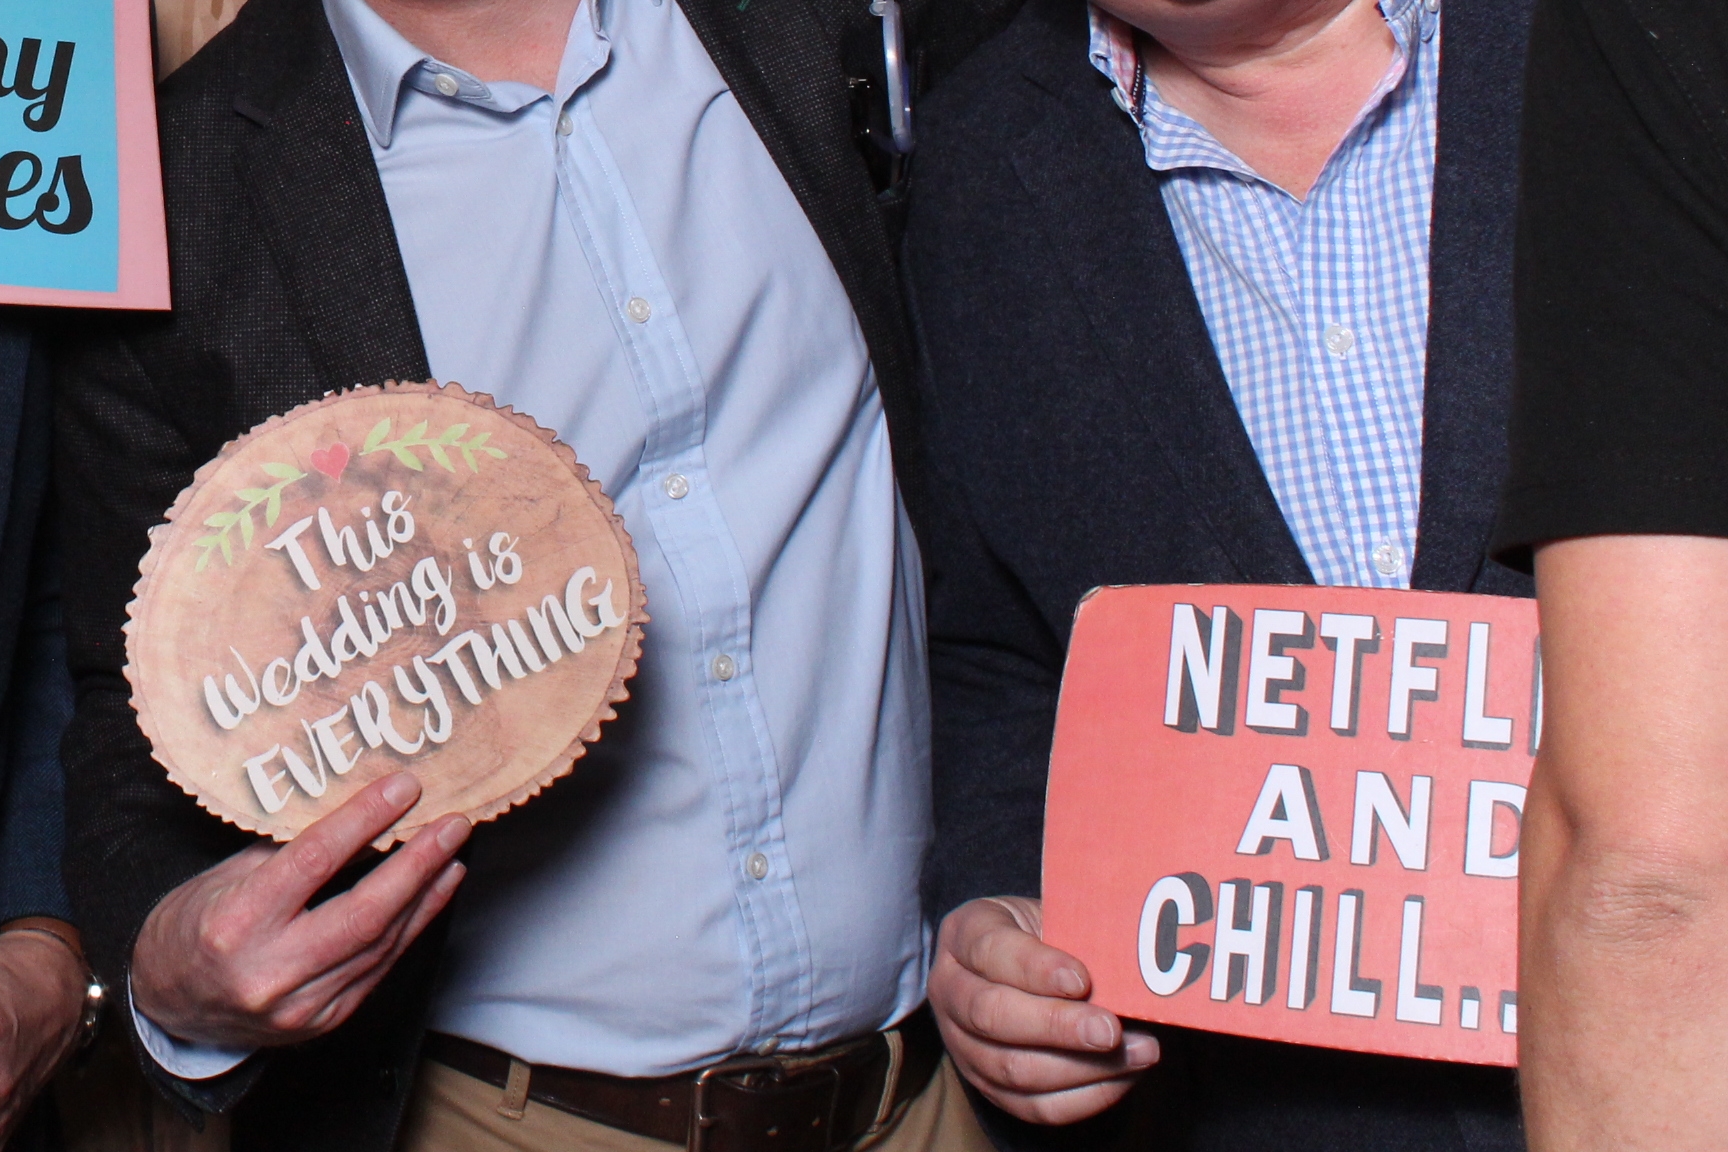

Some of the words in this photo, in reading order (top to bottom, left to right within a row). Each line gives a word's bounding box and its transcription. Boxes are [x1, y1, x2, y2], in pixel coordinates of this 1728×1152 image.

[264, 491, 416, 591] This
[203, 556, 458, 731] Wedding
[468, 531, 524, 590] is
[243, 566, 629, 814] EVERYTHING
[1163, 603, 1544, 756] NETFL
[1235, 763, 1530, 879] AND
